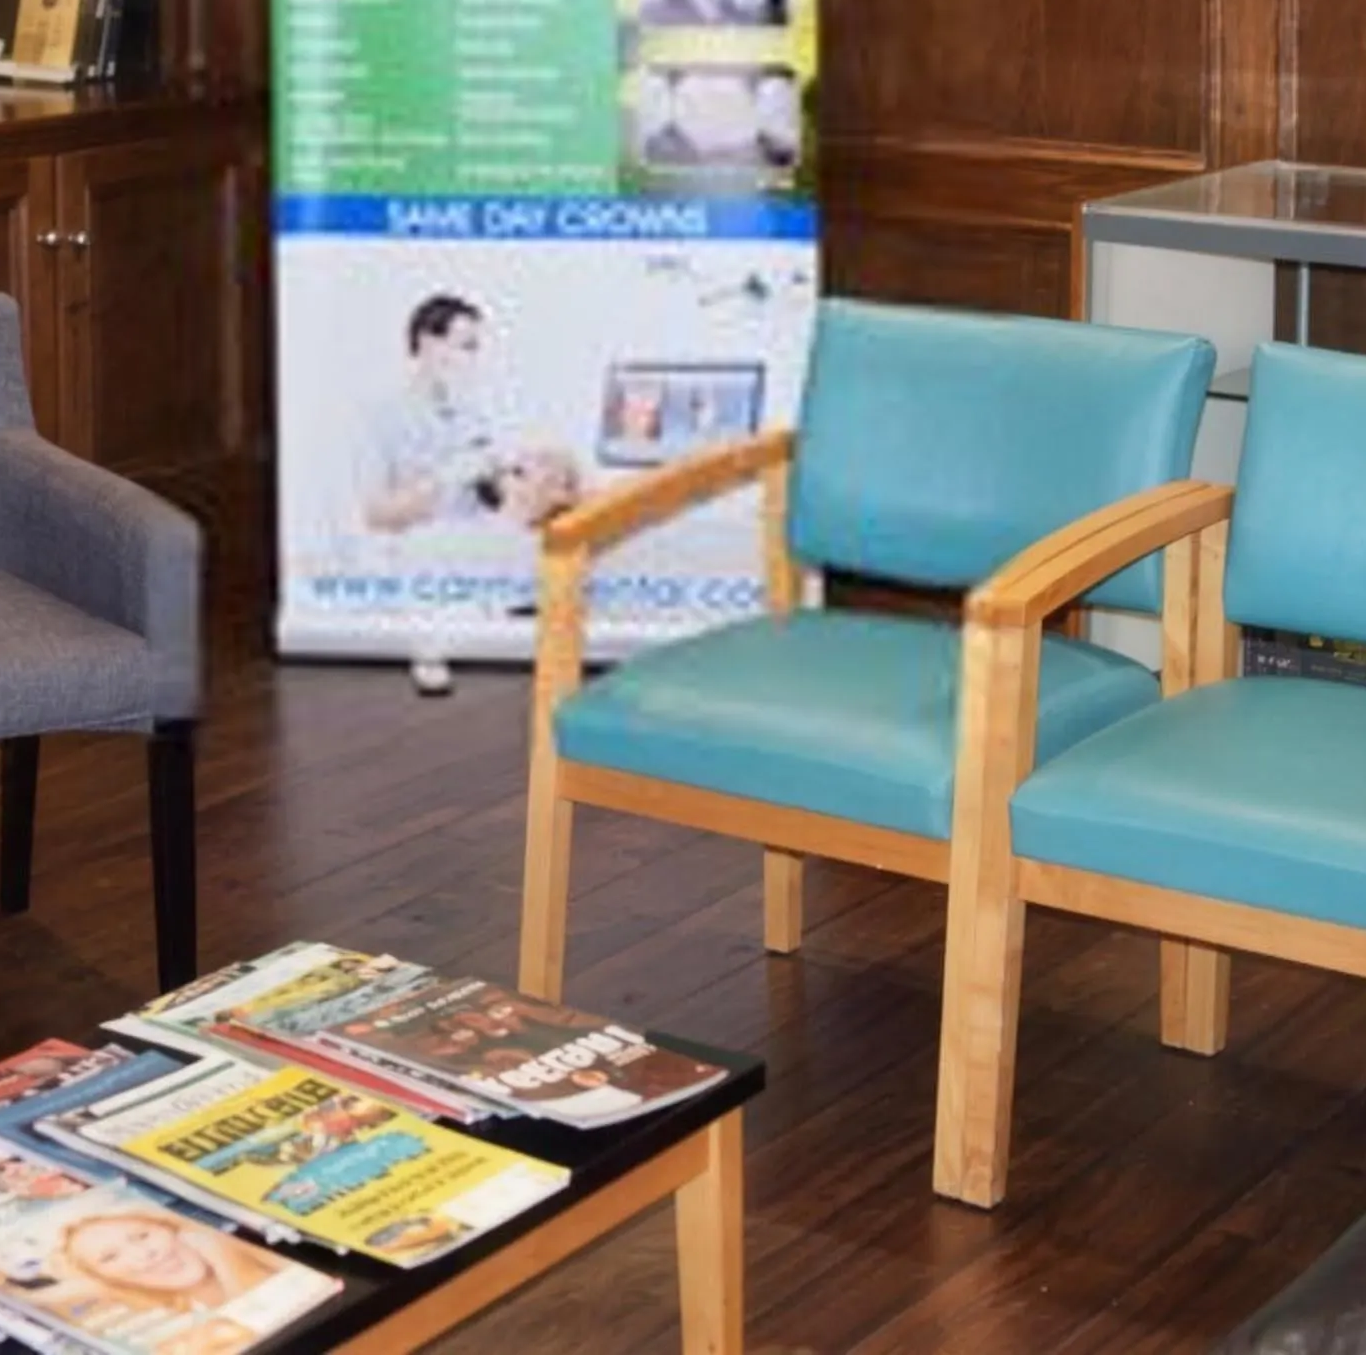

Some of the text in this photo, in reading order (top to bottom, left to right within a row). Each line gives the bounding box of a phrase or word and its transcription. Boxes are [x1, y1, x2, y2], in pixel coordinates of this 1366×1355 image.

[387, 203, 707, 236] SAME DAY CROWNS
